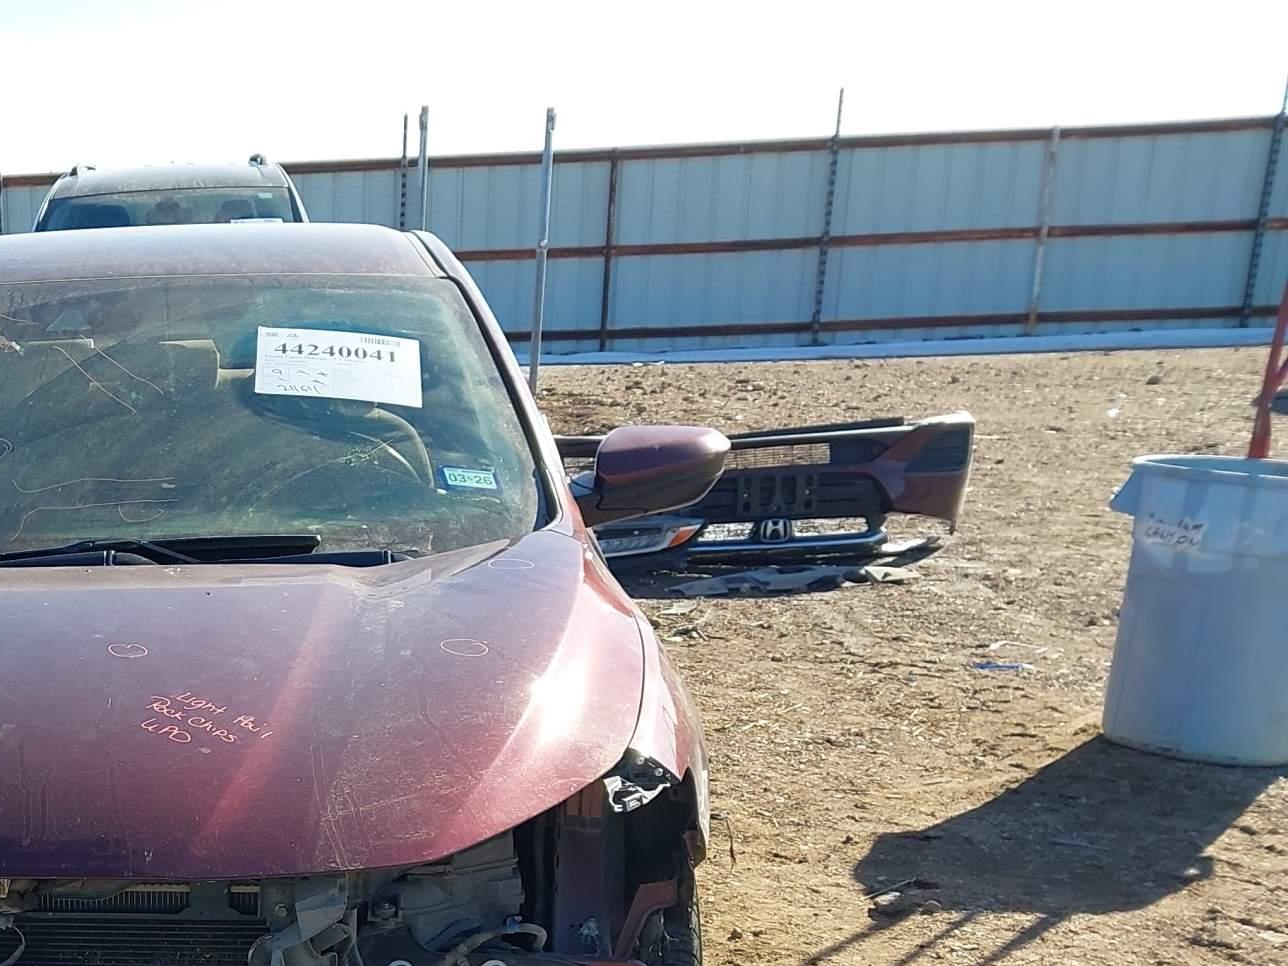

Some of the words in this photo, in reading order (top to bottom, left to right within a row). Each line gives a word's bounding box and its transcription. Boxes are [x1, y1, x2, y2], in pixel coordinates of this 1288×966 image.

[274, 342, 396, 363] 44240041
[145, 695, 188, 721] Rock
[187, 715, 239, 744] Chips
